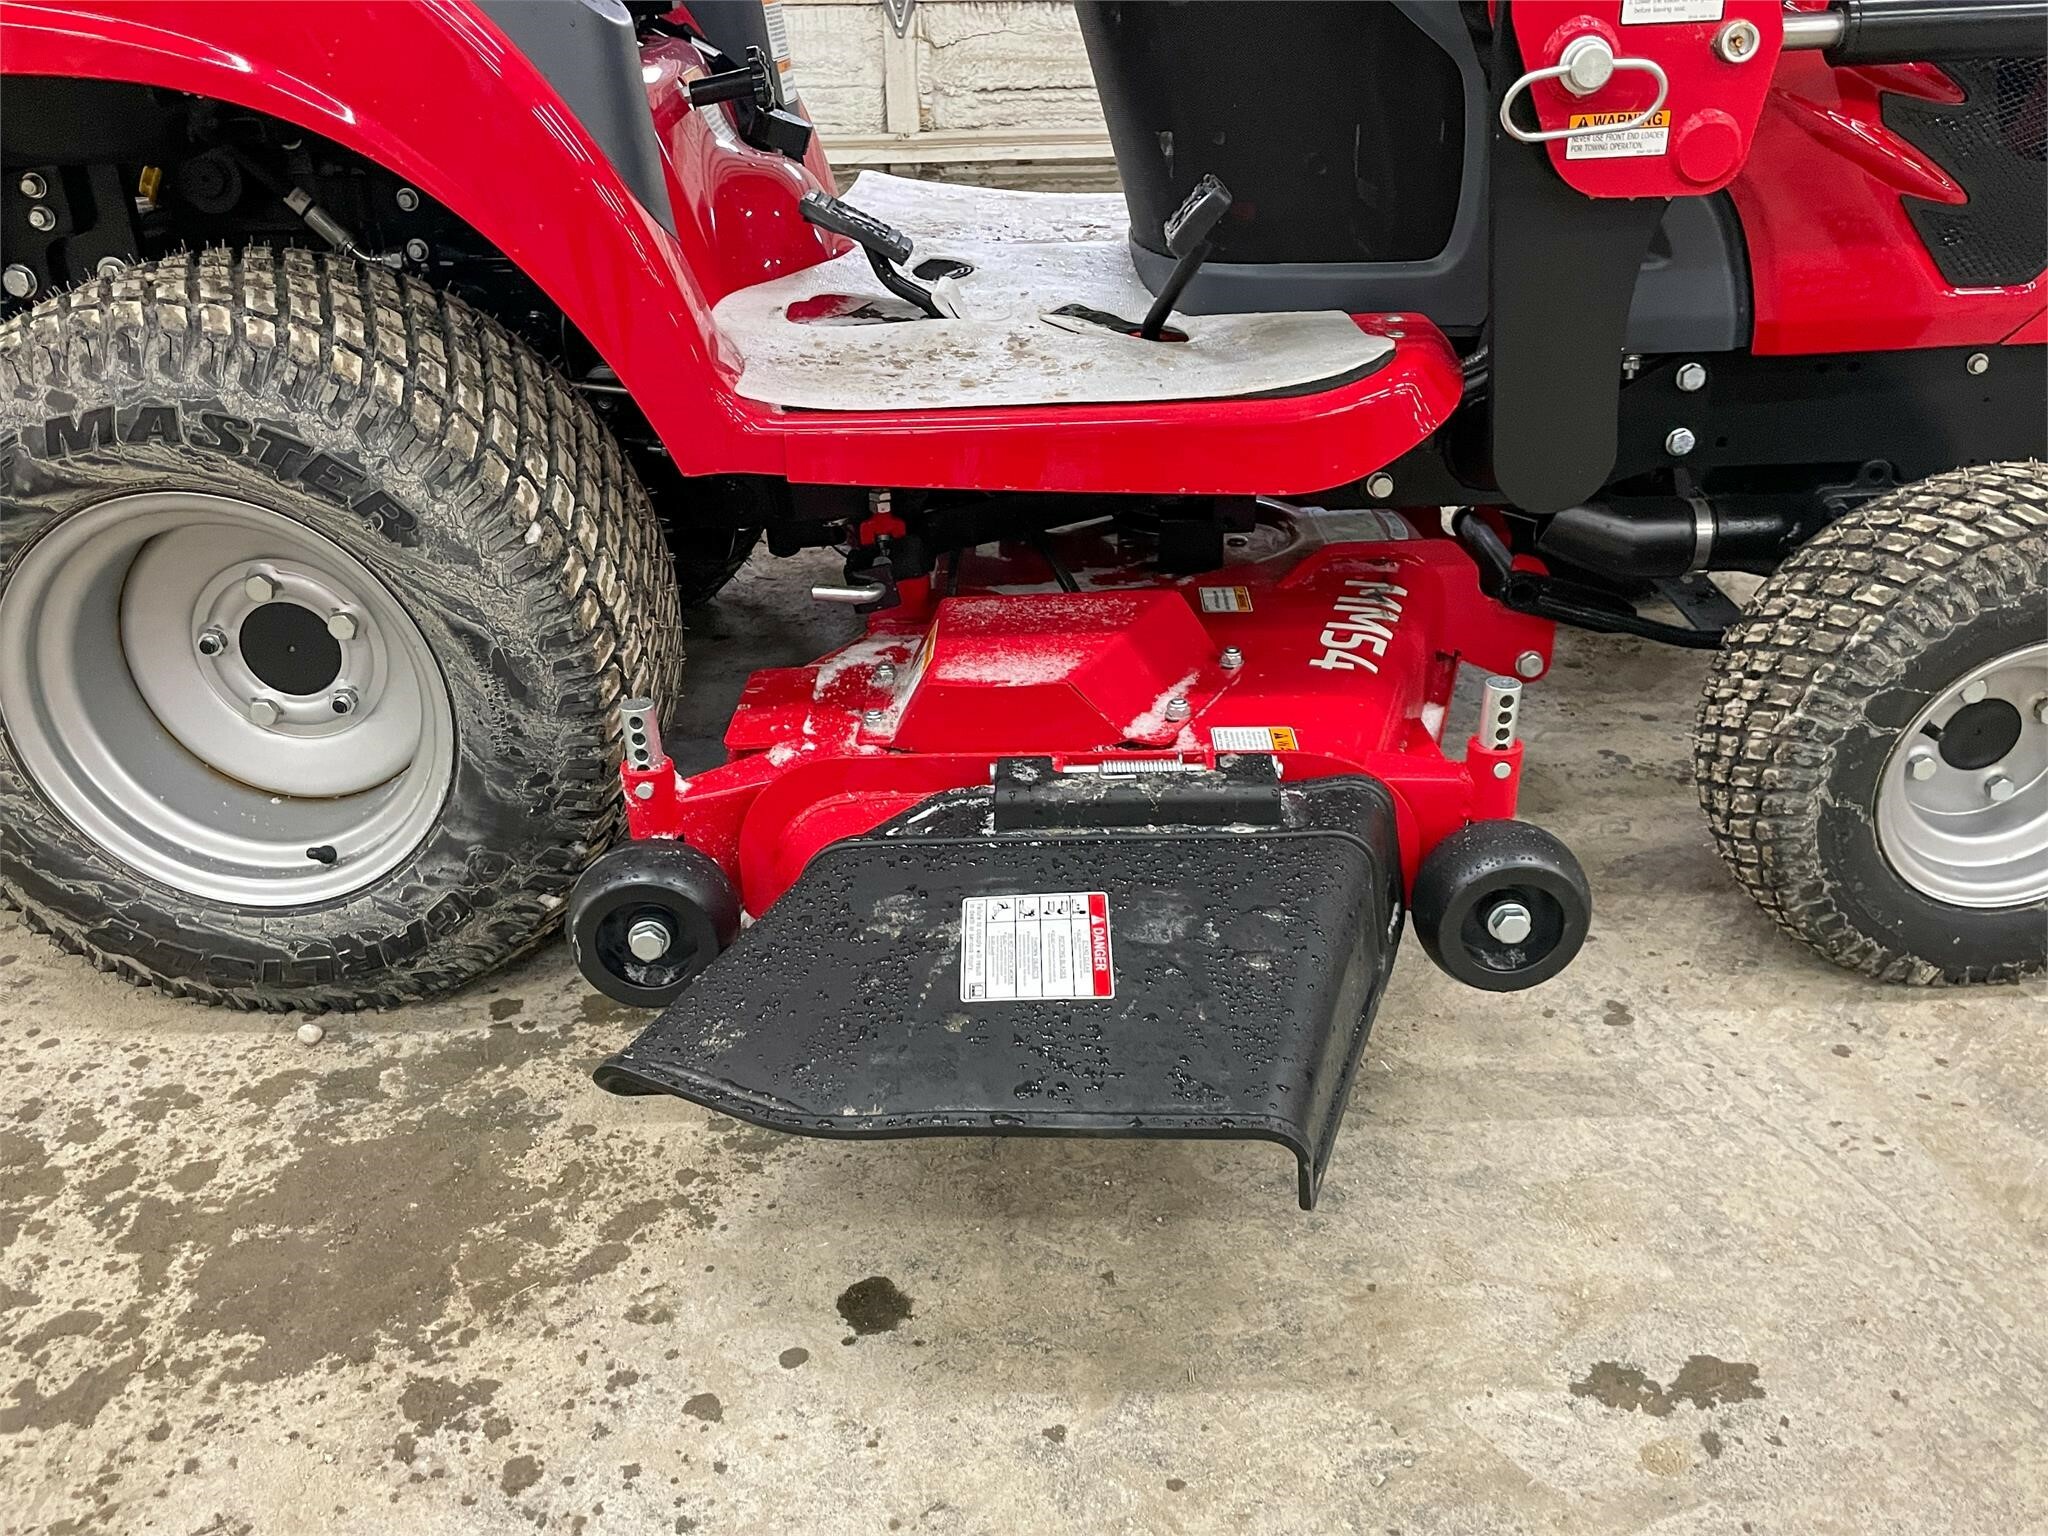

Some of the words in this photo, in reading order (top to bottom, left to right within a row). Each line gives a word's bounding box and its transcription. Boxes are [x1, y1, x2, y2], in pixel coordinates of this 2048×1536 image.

[1570, 144, 1583, 152] FOR
[1585, 143, 1609, 151] TOWING
[1593, 134, 1604, 142] USE
[1605, 133, 1625, 141] FRONT
[1627, 132, 1639, 140] END
[1641, 130, 1664, 139] LOADER
[44, 405, 418, 543] MASTER
[1309, 580, 1408, 674] MM54
[1093, 927, 1107, 971] DANGER
